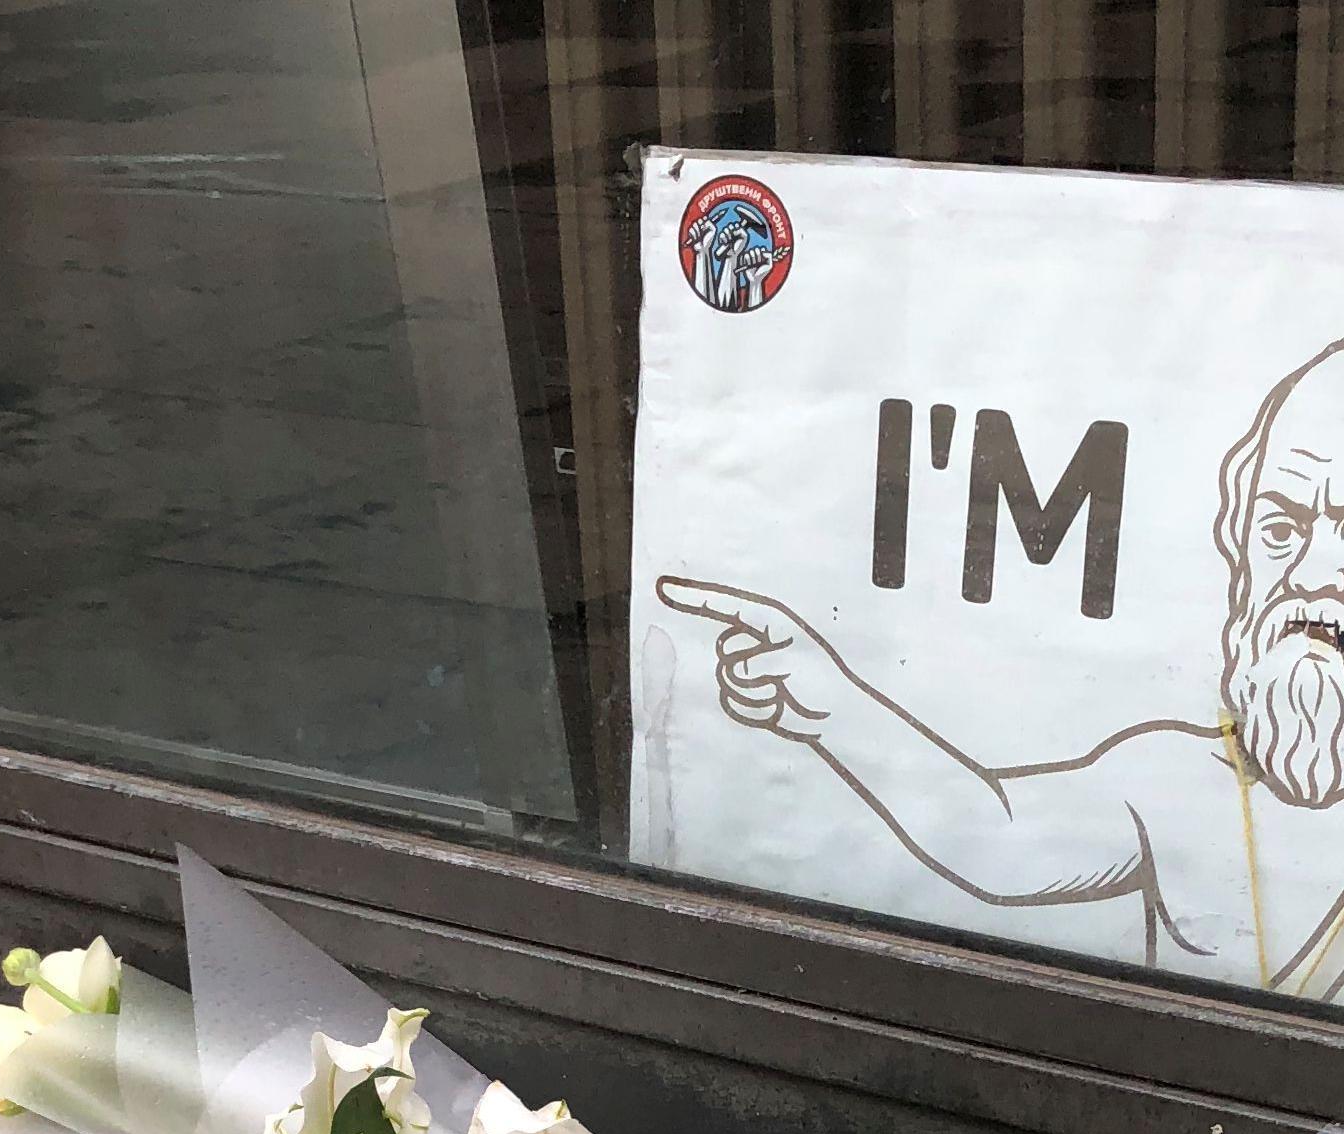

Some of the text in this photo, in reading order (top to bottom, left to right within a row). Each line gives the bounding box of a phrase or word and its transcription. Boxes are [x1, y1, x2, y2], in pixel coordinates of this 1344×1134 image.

[698, 184, 787, 240] ДРУШТВЕНИ ФРОНТ
[872, 398, 1130, 620] I'M
